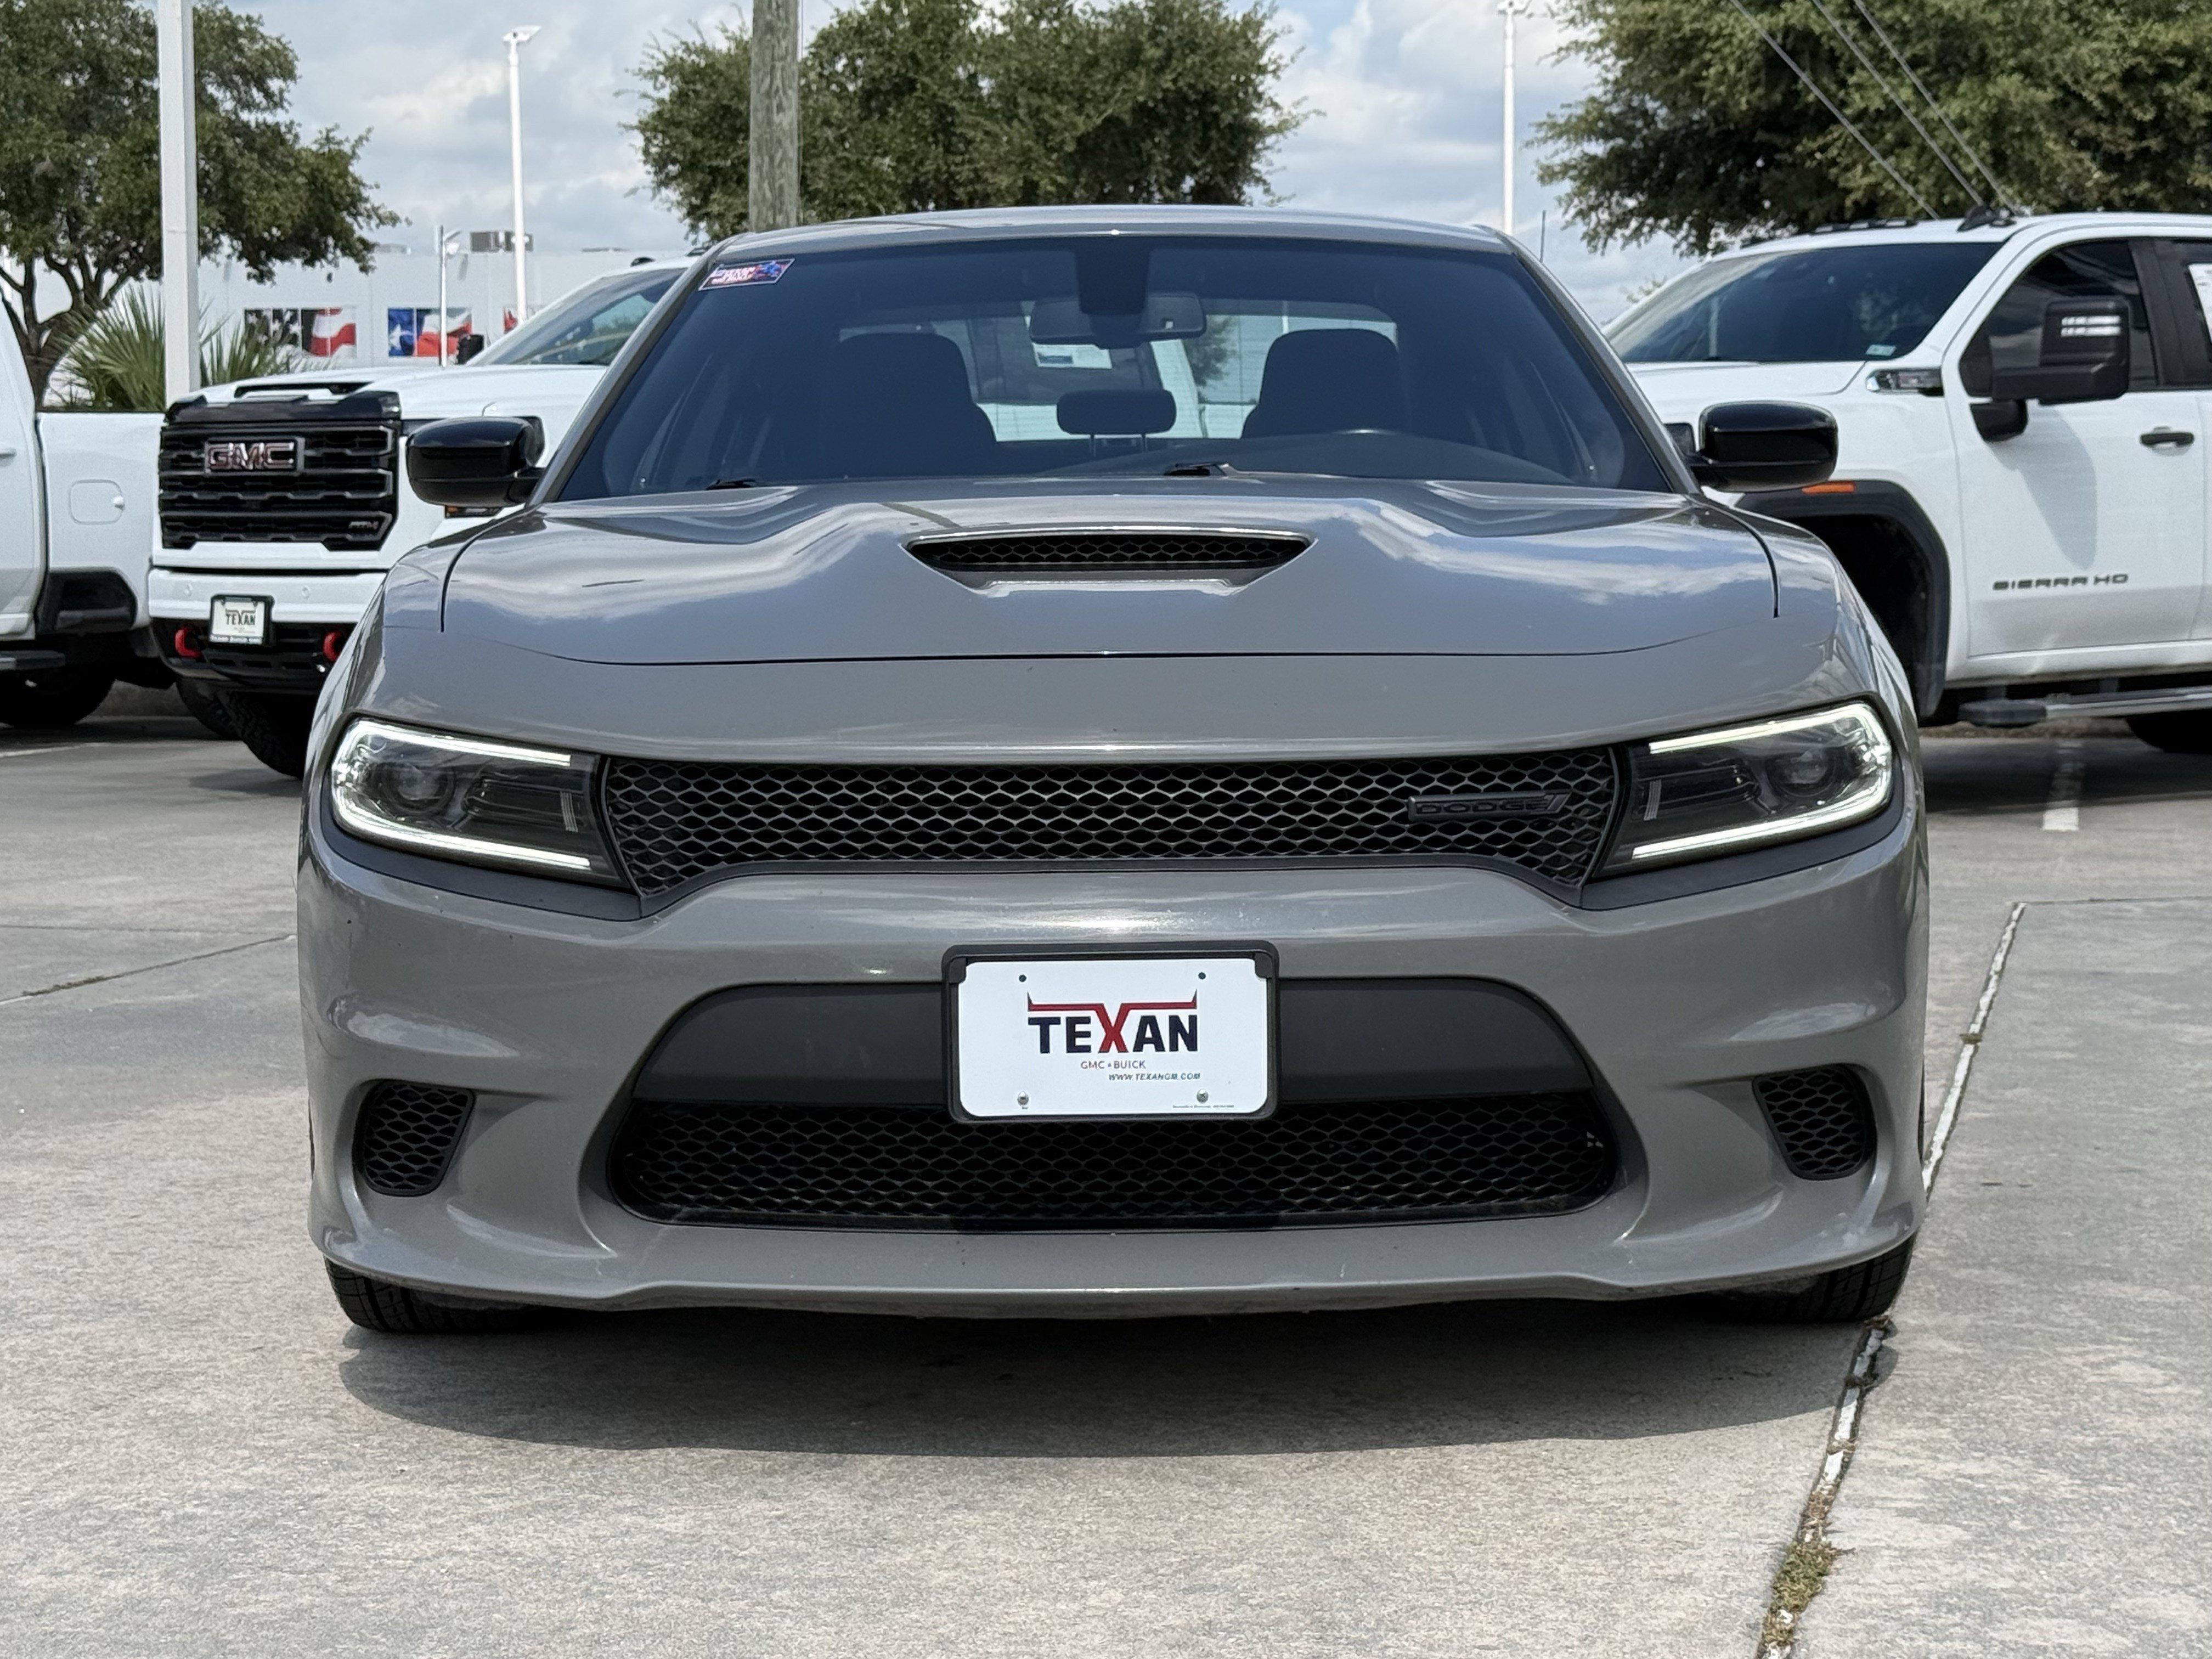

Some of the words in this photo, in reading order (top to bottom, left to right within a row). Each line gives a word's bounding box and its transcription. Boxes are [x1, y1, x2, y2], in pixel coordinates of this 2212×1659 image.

[208, 442, 295, 470] GMC
[1993, 577, 2088, 591] SIERRA
[2094, 574, 2129, 585] HD
[225, 611, 256, 625] TEXAN
[1415, 797, 1548, 815] DODGE
[1028, 1003, 1198, 1054] TEXAN
[1081, 1060, 1105, 1069] GMC
[1114, 1060, 1147, 1069] BUICK
